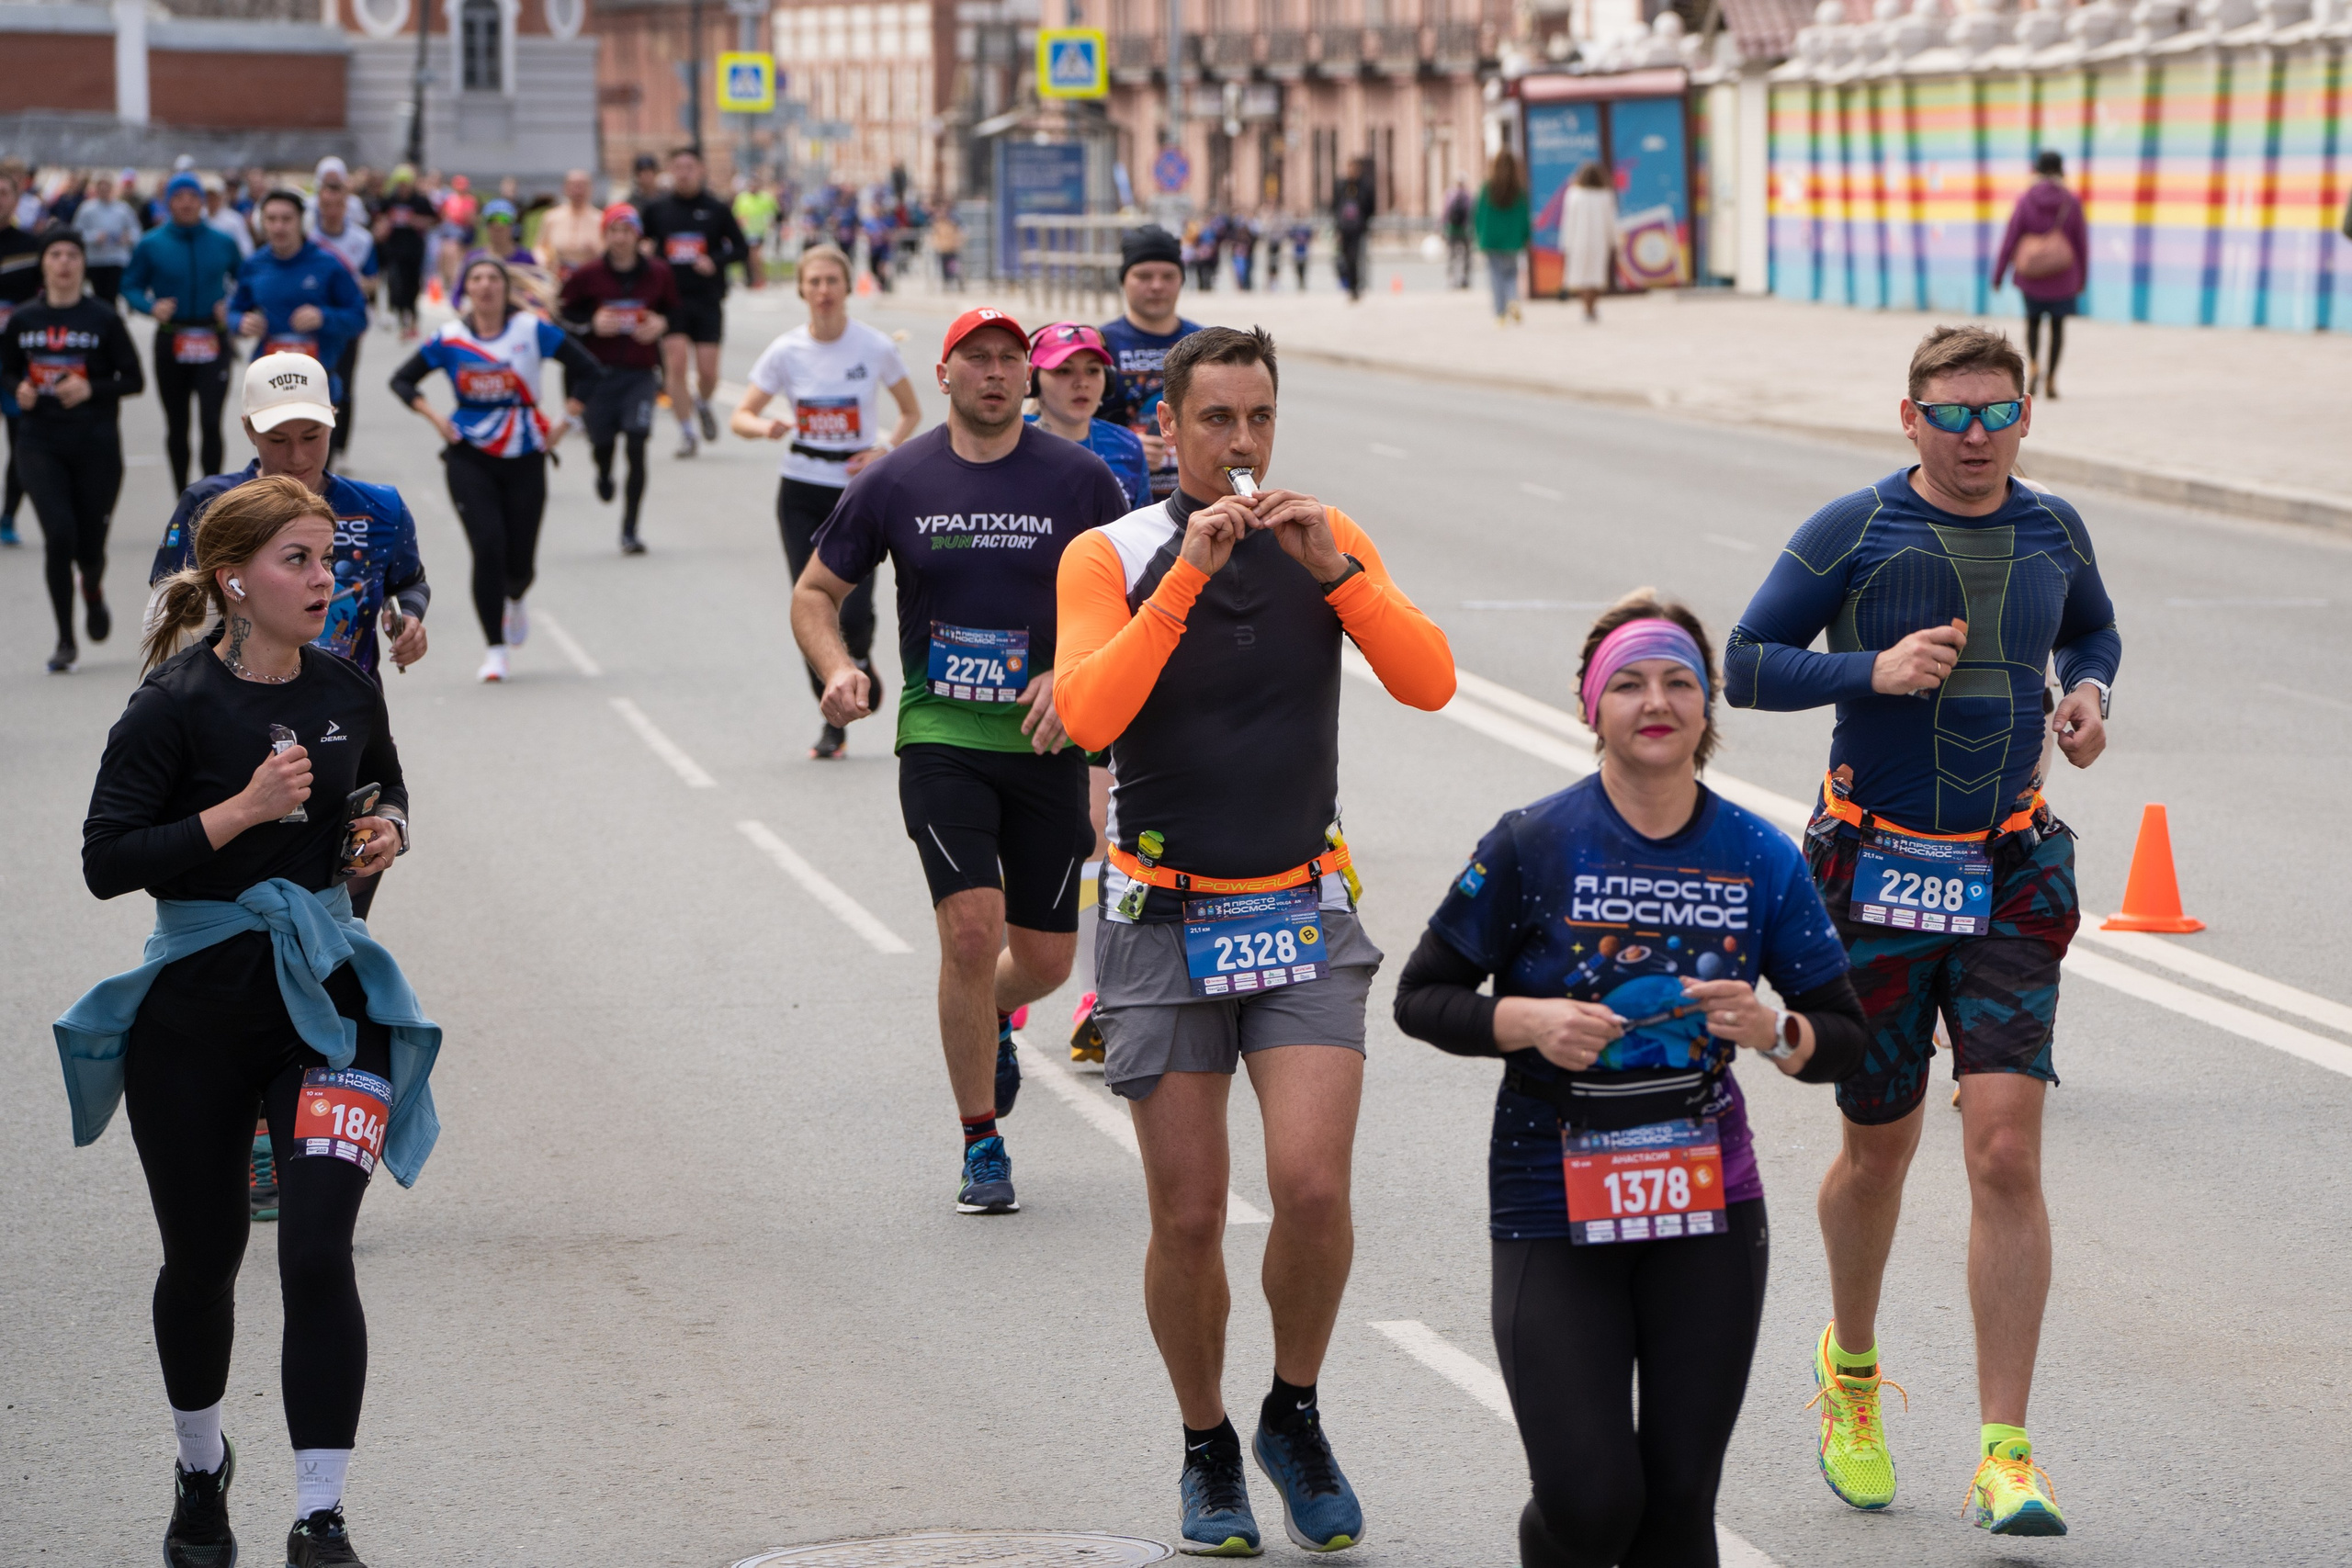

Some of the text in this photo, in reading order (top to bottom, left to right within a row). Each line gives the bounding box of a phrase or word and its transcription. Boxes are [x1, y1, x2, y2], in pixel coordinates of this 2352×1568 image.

[1120, 359, 1164, 372] КОС
[269, 373, 308, 389] YOUTH
[915, 513, 1052, 535] УРАЛХИМ
[945, 655, 1005, 685] 2274
[1899, 844, 1952, 858] КОСМОС
[1909, 841, 1953, 850] ПРОСТО
[1198, 871, 1303, 891] POWERUP
[1575, 875, 1747, 904] Я ПРОСТО
[1879, 869, 1964, 912] 2288
[1970, 885, 1982, 897] D
[1224, 903, 1276, 915] КОСМОС
[1232, 897, 1276, 906] ПРОСТО
[1572, 897, 1748, 929] КОСМОС
[1303, 929, 1315, 941] B
[1214, 930, 1297, 971] 2328
[345, 1079, 389, 1100] КОСМОС
[355, 1074, 390, 1094] ПРОСТО
[314, 1102, 327, 1113] E
[332, 1104, 384, 1156] 1841
[1621, 1126, 1673, 1136] ПРОСТО
[1611, 1134, 1673, 1146] КОСМОС
[1611, 1151, 1670, 1165] АНАСТАСИЯ
[1604, 1166, 1691, 1214] 1378
